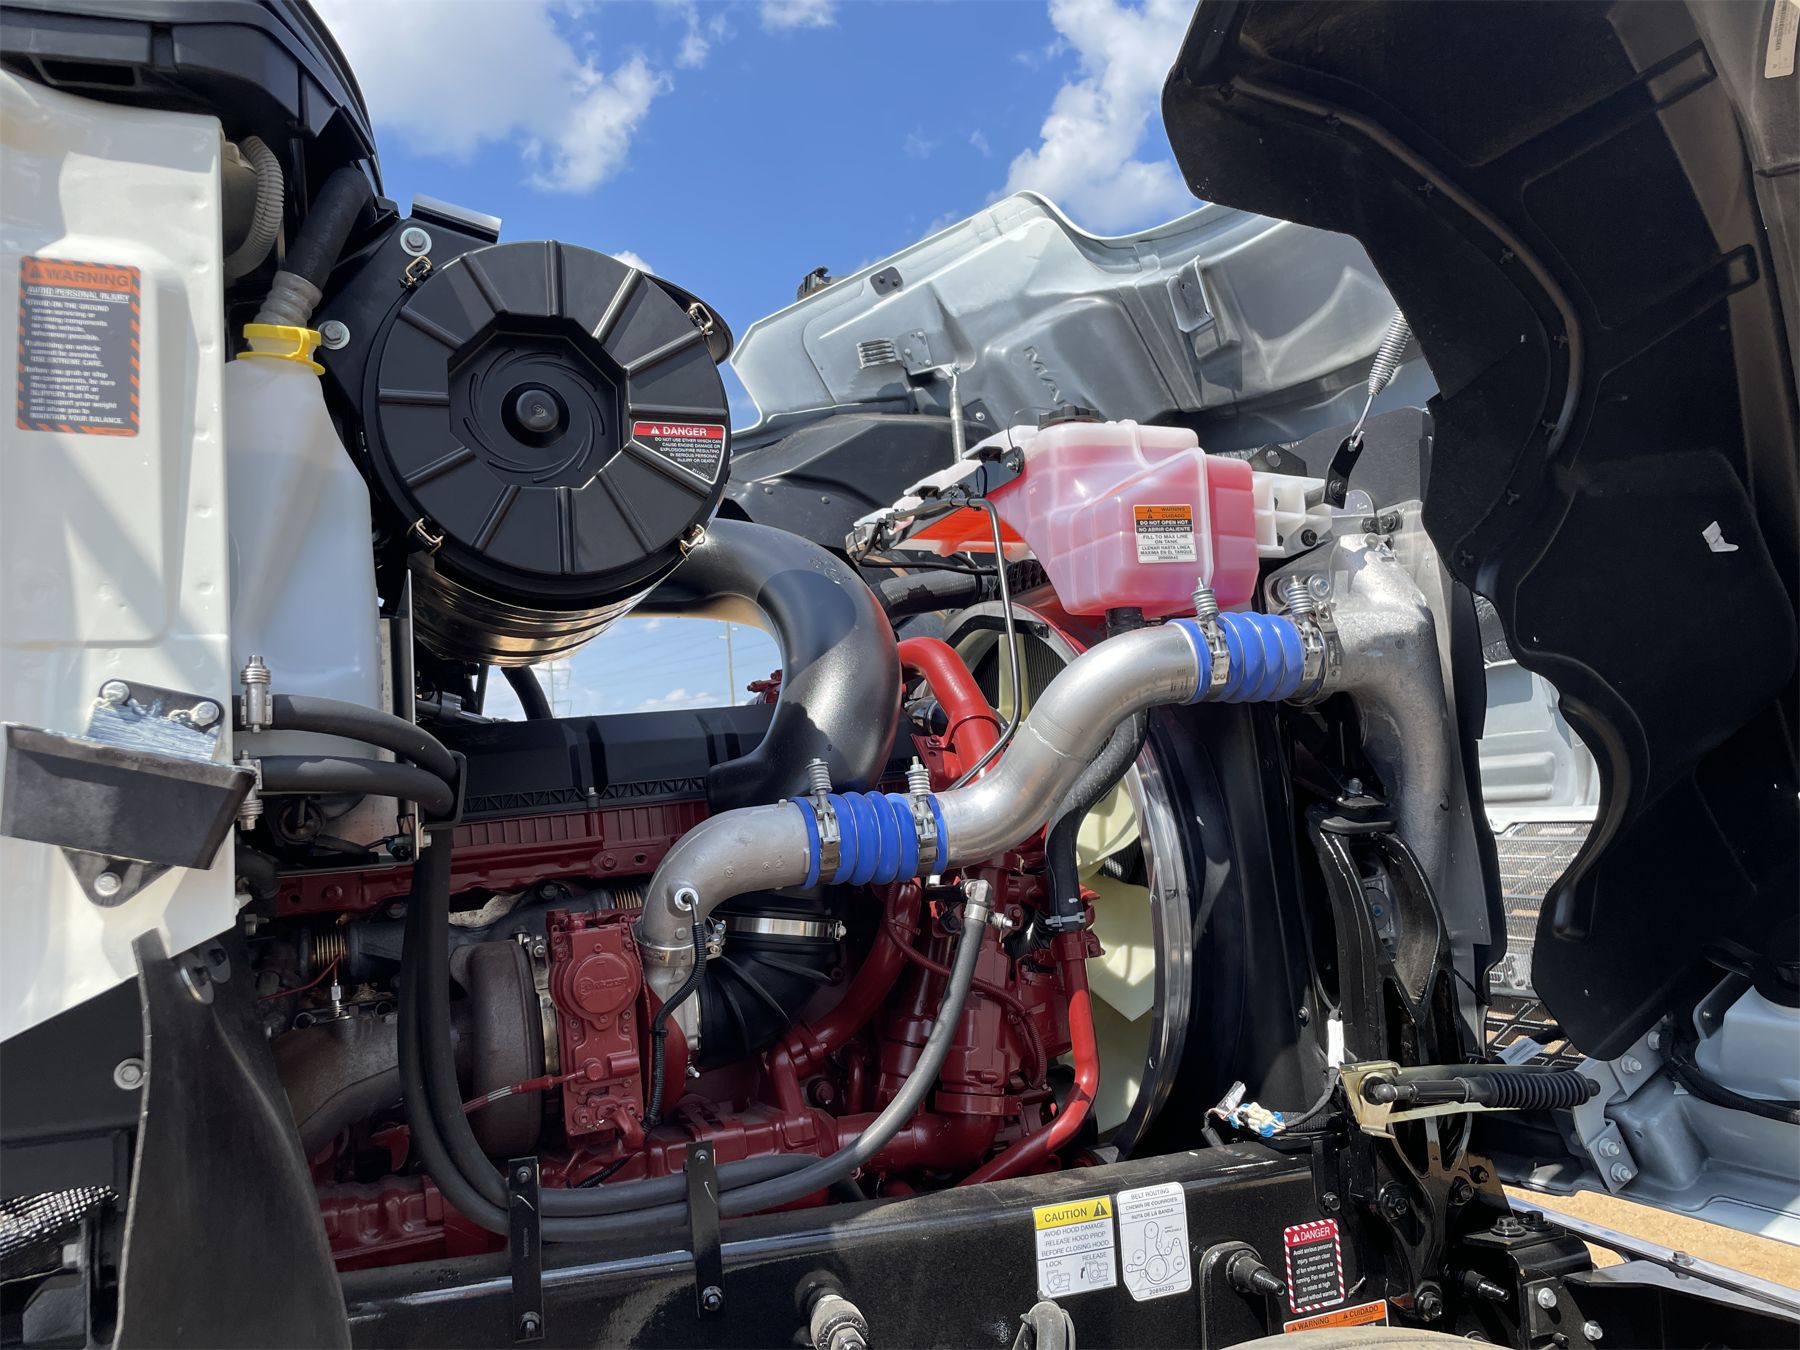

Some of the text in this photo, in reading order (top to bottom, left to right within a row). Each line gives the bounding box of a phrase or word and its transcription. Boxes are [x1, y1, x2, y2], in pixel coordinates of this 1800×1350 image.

[46, 268, 128, 286] WARNING
[55, 288, 97, 298] PERSONAL
[92, 402, 117, 410] weight
[68, 414, 88, 422] YOUR
[663, 426, 707, 436] DANGER
[1130, 1188, 1170, 1201] BELT ROUTING
[1126, 1202, 1144, 1211] CHEMIN
[1151, 1196, 1178, 1207] COURROIES
[1044, 1207, 1088, 1224] CAUTION
[1158, 1207, 1174, 1216] BANDA
[1043, 1230, 1062, 1238] AVOID
[1062, 1226, 1080, 1236] HOOD
[1300, 1227, 1331, 1241] DANGER
[1045, 1230, 1106, 1247] RELEASE HOOD PROP
[1040, 1248, 1065, 1258] BEFORE
[1065, 1242, 1091, 1253] CLOSING
[1304, 1246, 1318, 1254] serious
[1317, 1242, 1333, 1252] personal
[1082, 1251, 1107, 1262] RELEASE
[1322, 1252, 1331, 1260] clear
[1045, 1259, 1062, 1268] LOCK
[1307, 1264, 1317, 1272] when
[1317, 1262, 1330, 1270] engine
[1318, 1272, 1327, 1280] may
[1308, 1284, 1318, 1292] rotate
[1323, 1280, 1331, 1289] high
[1296, 1296, 1309, 1304] speed
[1309, 1292, 1322, 1301] without
[1297, 1304, 1378, 1330] WARNING CUIDADO
